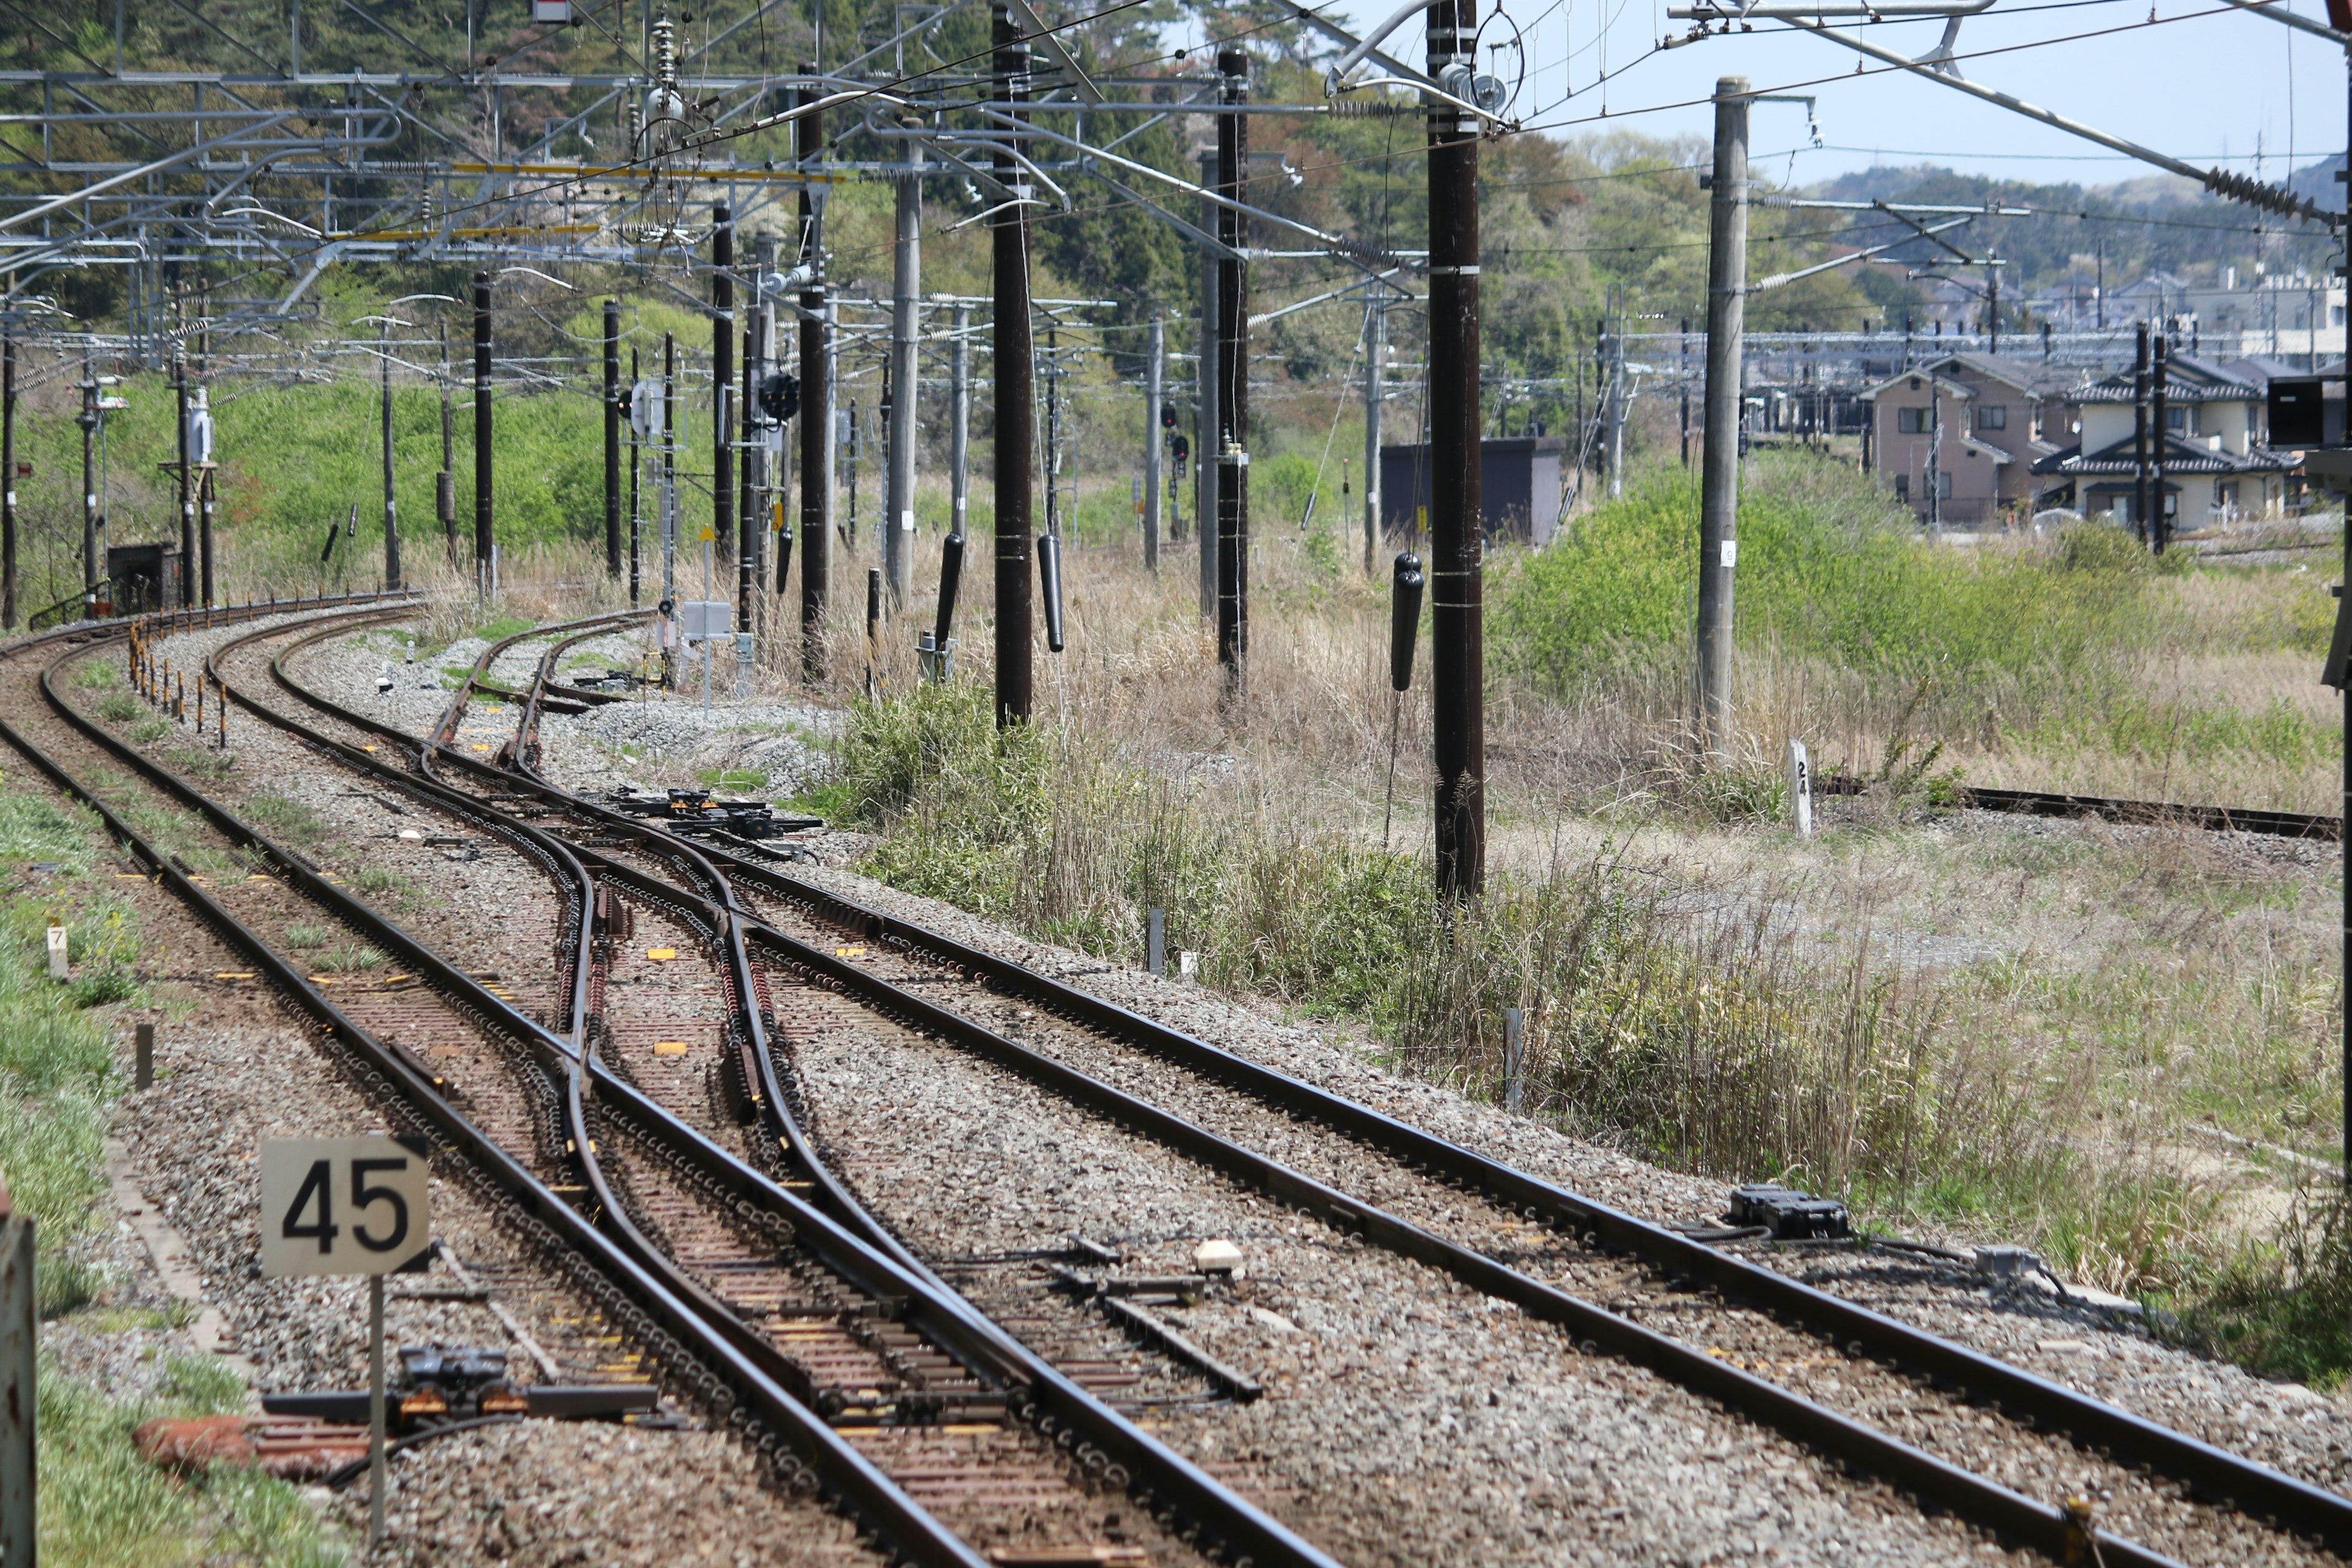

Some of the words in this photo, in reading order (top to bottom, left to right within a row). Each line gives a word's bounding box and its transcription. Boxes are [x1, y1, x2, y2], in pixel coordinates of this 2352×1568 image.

[1727, 551, 1733, 560] 9
[51, 931, 63, 944] 7
[282, 1158, 408, 1254] 45
